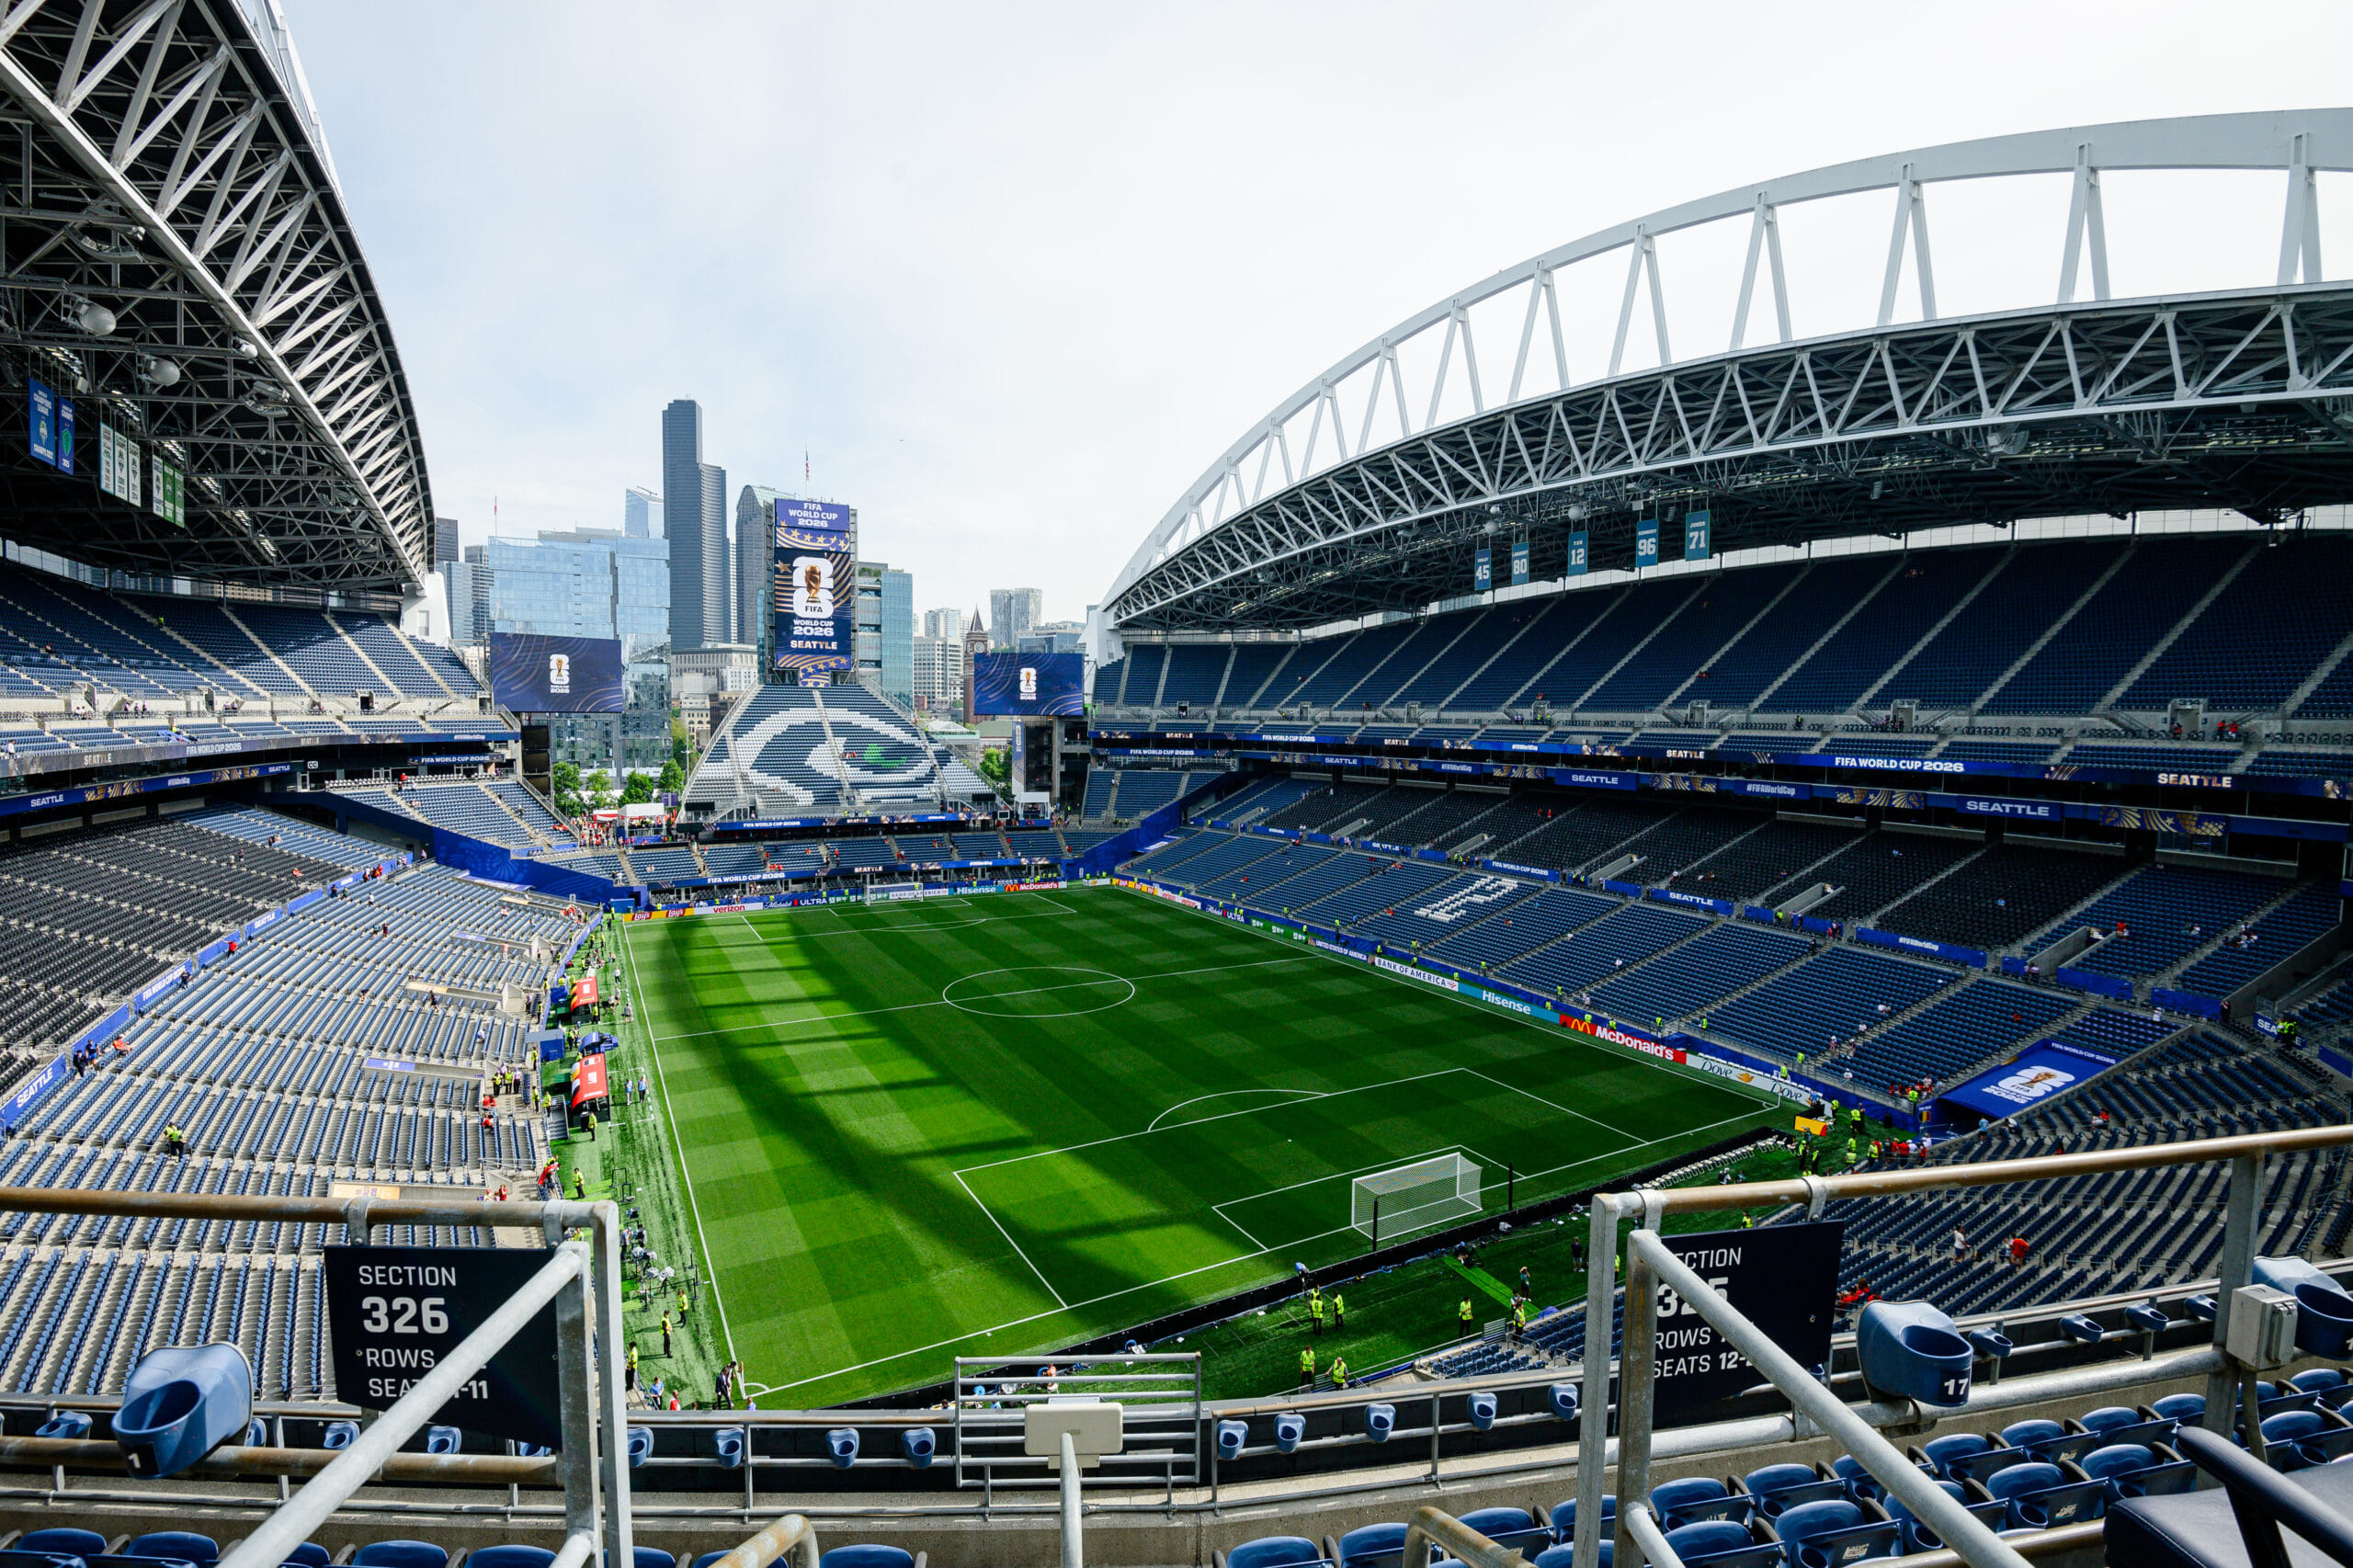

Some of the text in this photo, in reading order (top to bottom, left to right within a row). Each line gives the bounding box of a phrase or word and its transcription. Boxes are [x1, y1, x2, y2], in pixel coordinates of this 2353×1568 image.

[789, 509, 838, 520] WORLD CUP
[803, 503, 823, 511] FIFA
[798, 518, 828, 528] 2026
[1638, 538, 1656, 556] 96
[1689, 530, 1706, 550] 71
[1571, 548, 1585, 565] 12
[1476, 564, 1490, 581] 45
[1513, 558, 1527, 575] 80
[793, 619, 834, 628] WORLD CUP
[793, 626, 835, 637] 2026
[790, 640, 838, 650] SEATTLE
[186, 745, 198, 756] FIFA
[215, 744, 224, 752] CUP
[1383, 738, 1409, 746] SEATTLE
[84, 753, 112, 766] SEATTLE
[1324, 757, 1358, 766] SEATTLE
[1666, 749, 1705, 759] SEATTLE
[268, 765, 290, 773] SEATTLE
[1835, 756, 1964, 772] FIFA WORLD CUP 2026
[1571, 774, 1619, 785] SEATTLE
[2157, 773, 2233, 789] SEATTLE
[1746, 783, 1796, 796] #FIFAWorldCup
[30, 794, 64, 808] SEATTLE
[1966, 801, 2050, 817] SEATTLE
[707, 876, 722, 884] FIFA
[722, 875, 747, 883] WORLD
[762, 872, 785, 881] 2026
[1019, 881, 1058, 891] McDonald's
[956, 886, 996, 895] Hisense
[800, 898, 827, 906] ULTRA
[1668, 891, 1714, 907] SEATTLE
[713, 904, 745, 914] verizon
[1226, 911, 1245, 923] ULTRA
[1377, 958, 1447, 987] BANK OF AMERICA
[1482, 989, 1531, 1016] Hisense
[2256, 1018, 2302, 1046] SEAE
[1595, 1025, 1674, 1061] McDonald's
[1699, 1060, 1733, 1078] Dove
[17, 1066, 53, 1108] SEATTLE
[1770, 1081, 1802, 1100] Dove
[2010, 1084, 2030, 1094] FIFA
[1673, 1246, 1742, 1270] CTION
[358, 1265, 457, 1287] SECTION
[361, 1296, 449, 1335] 326
[1655, 1326, 1711, 1351] ROWS
[366, 1348, 436, 1369] ROWS
[1654, 1354, 1711, 1379] SEATS
[369, 1378, 488, 1400] SEA -11
[1943, 1377, 1970, 1396] 17
[128, 1452, 141, 1470] 1
